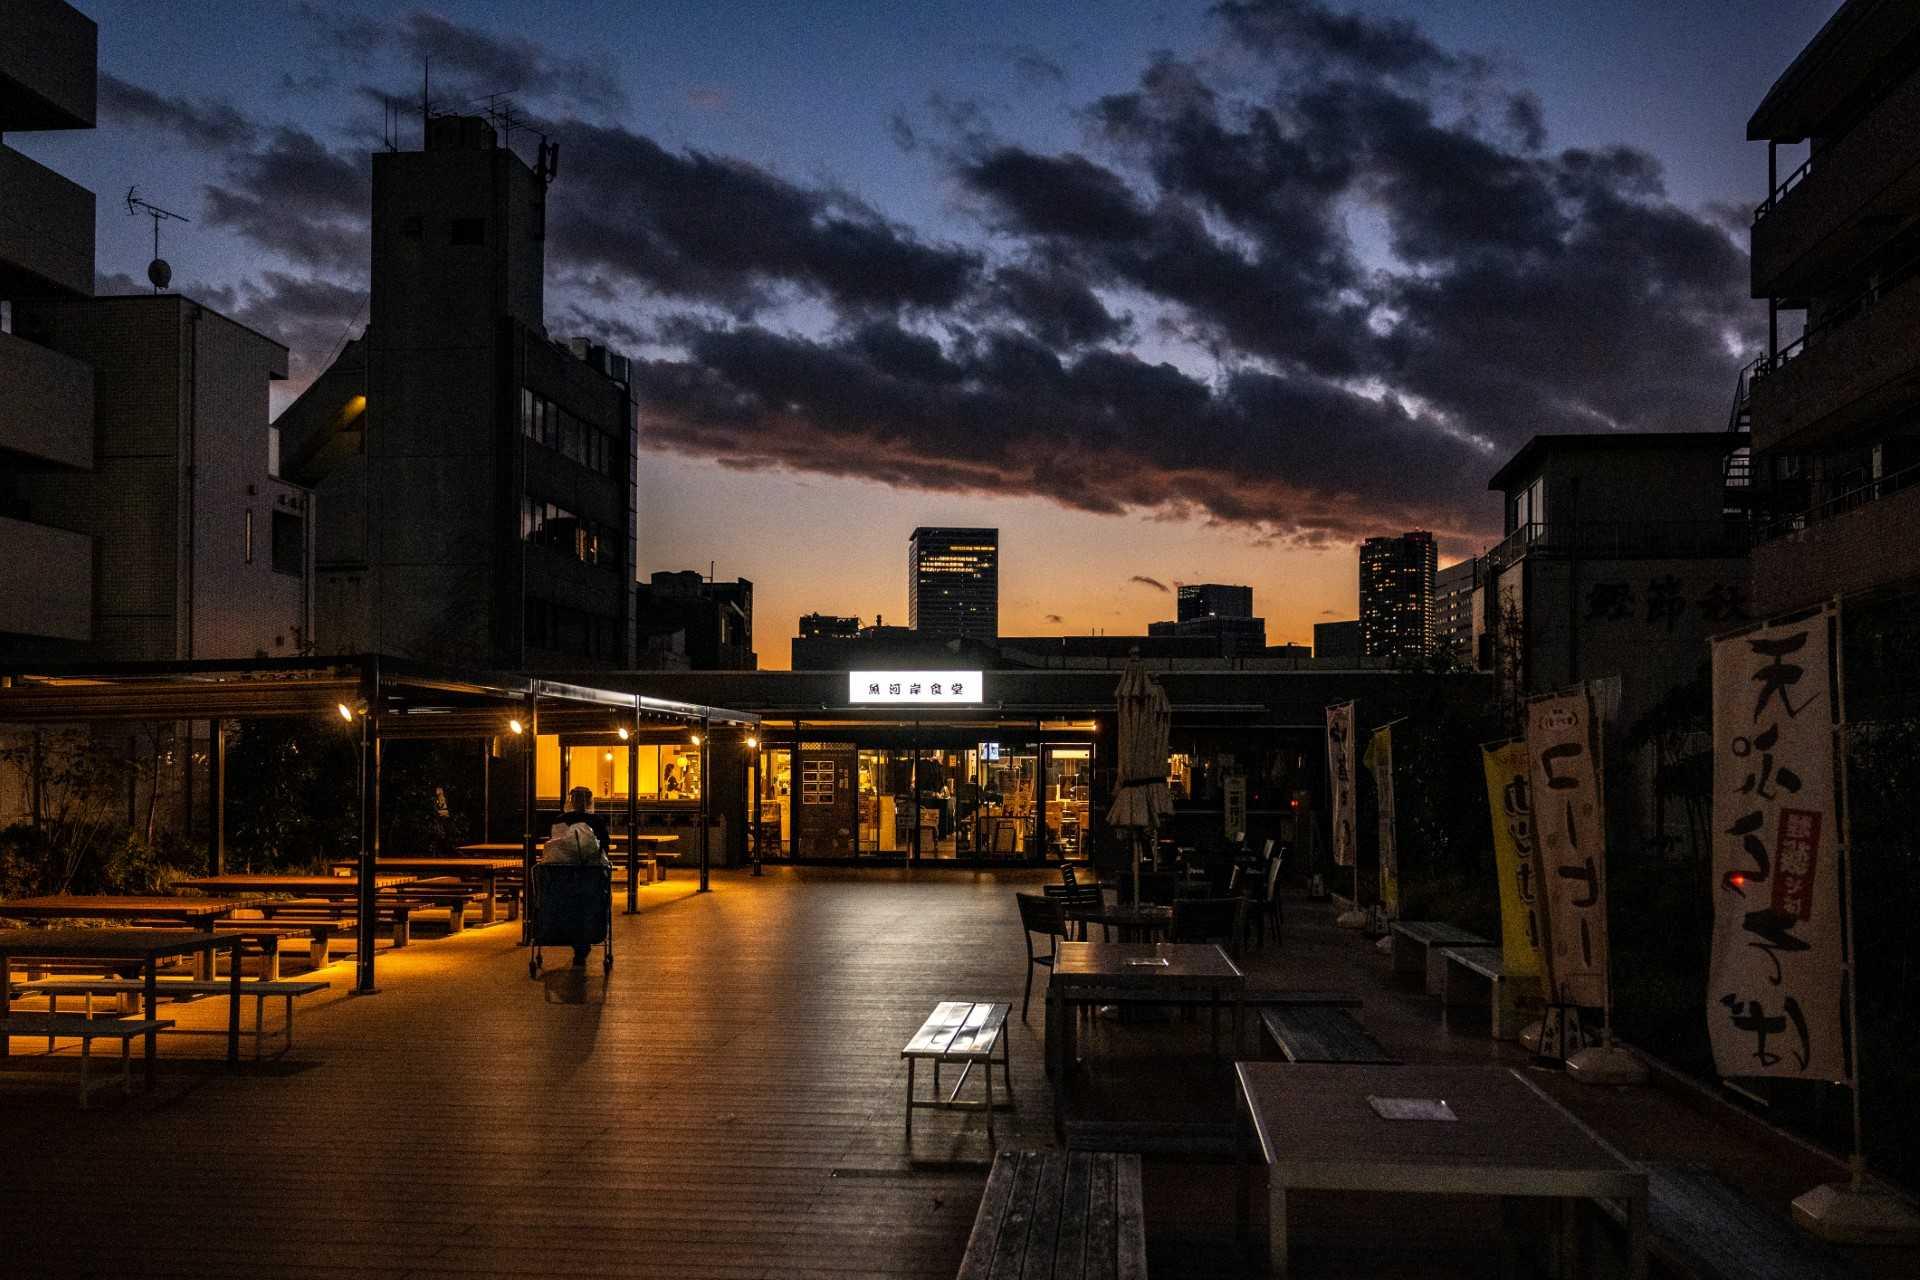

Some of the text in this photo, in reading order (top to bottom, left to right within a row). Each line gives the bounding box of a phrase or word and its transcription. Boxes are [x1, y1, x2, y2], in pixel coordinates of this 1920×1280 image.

[868, 683, 963, 695] 魚河岸食堂
